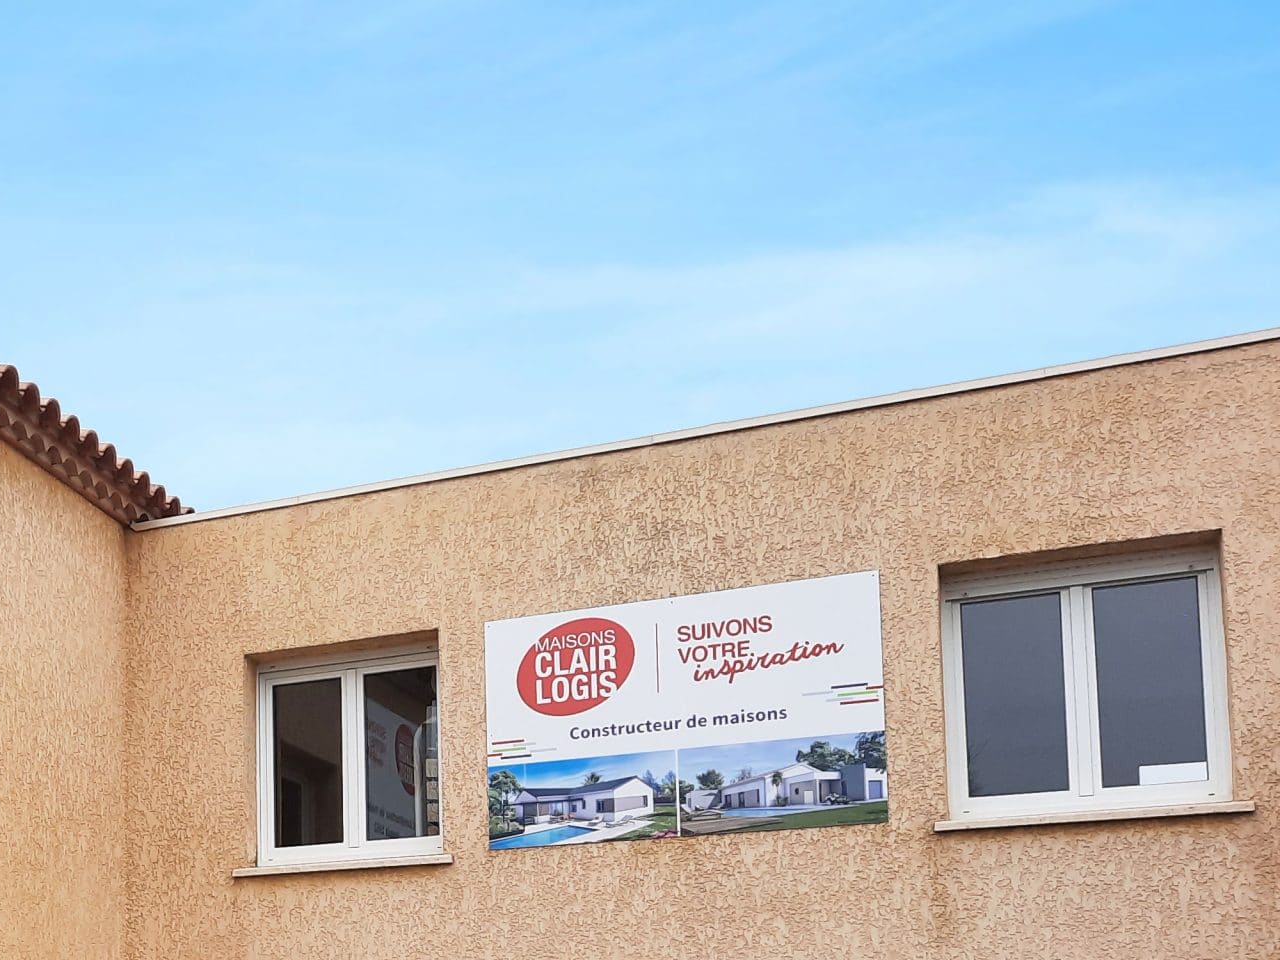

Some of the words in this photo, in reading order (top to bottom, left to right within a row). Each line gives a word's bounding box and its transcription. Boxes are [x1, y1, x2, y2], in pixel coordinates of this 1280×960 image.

[535, 629, 616, 652] MAISONS
[677, 614, 773, 642] SUIVONS
[534, 644, 617, 679] CLAIR
[677, 639, 750, 664] VOTRE
[693, 639, 844, 684] inspiration
[535, 669, 617, 705] LOGIS
[569, 717, 682, 741] Constructeur
[686, 714, 708, 729] de
[712, 706, 788, 726] maisons
